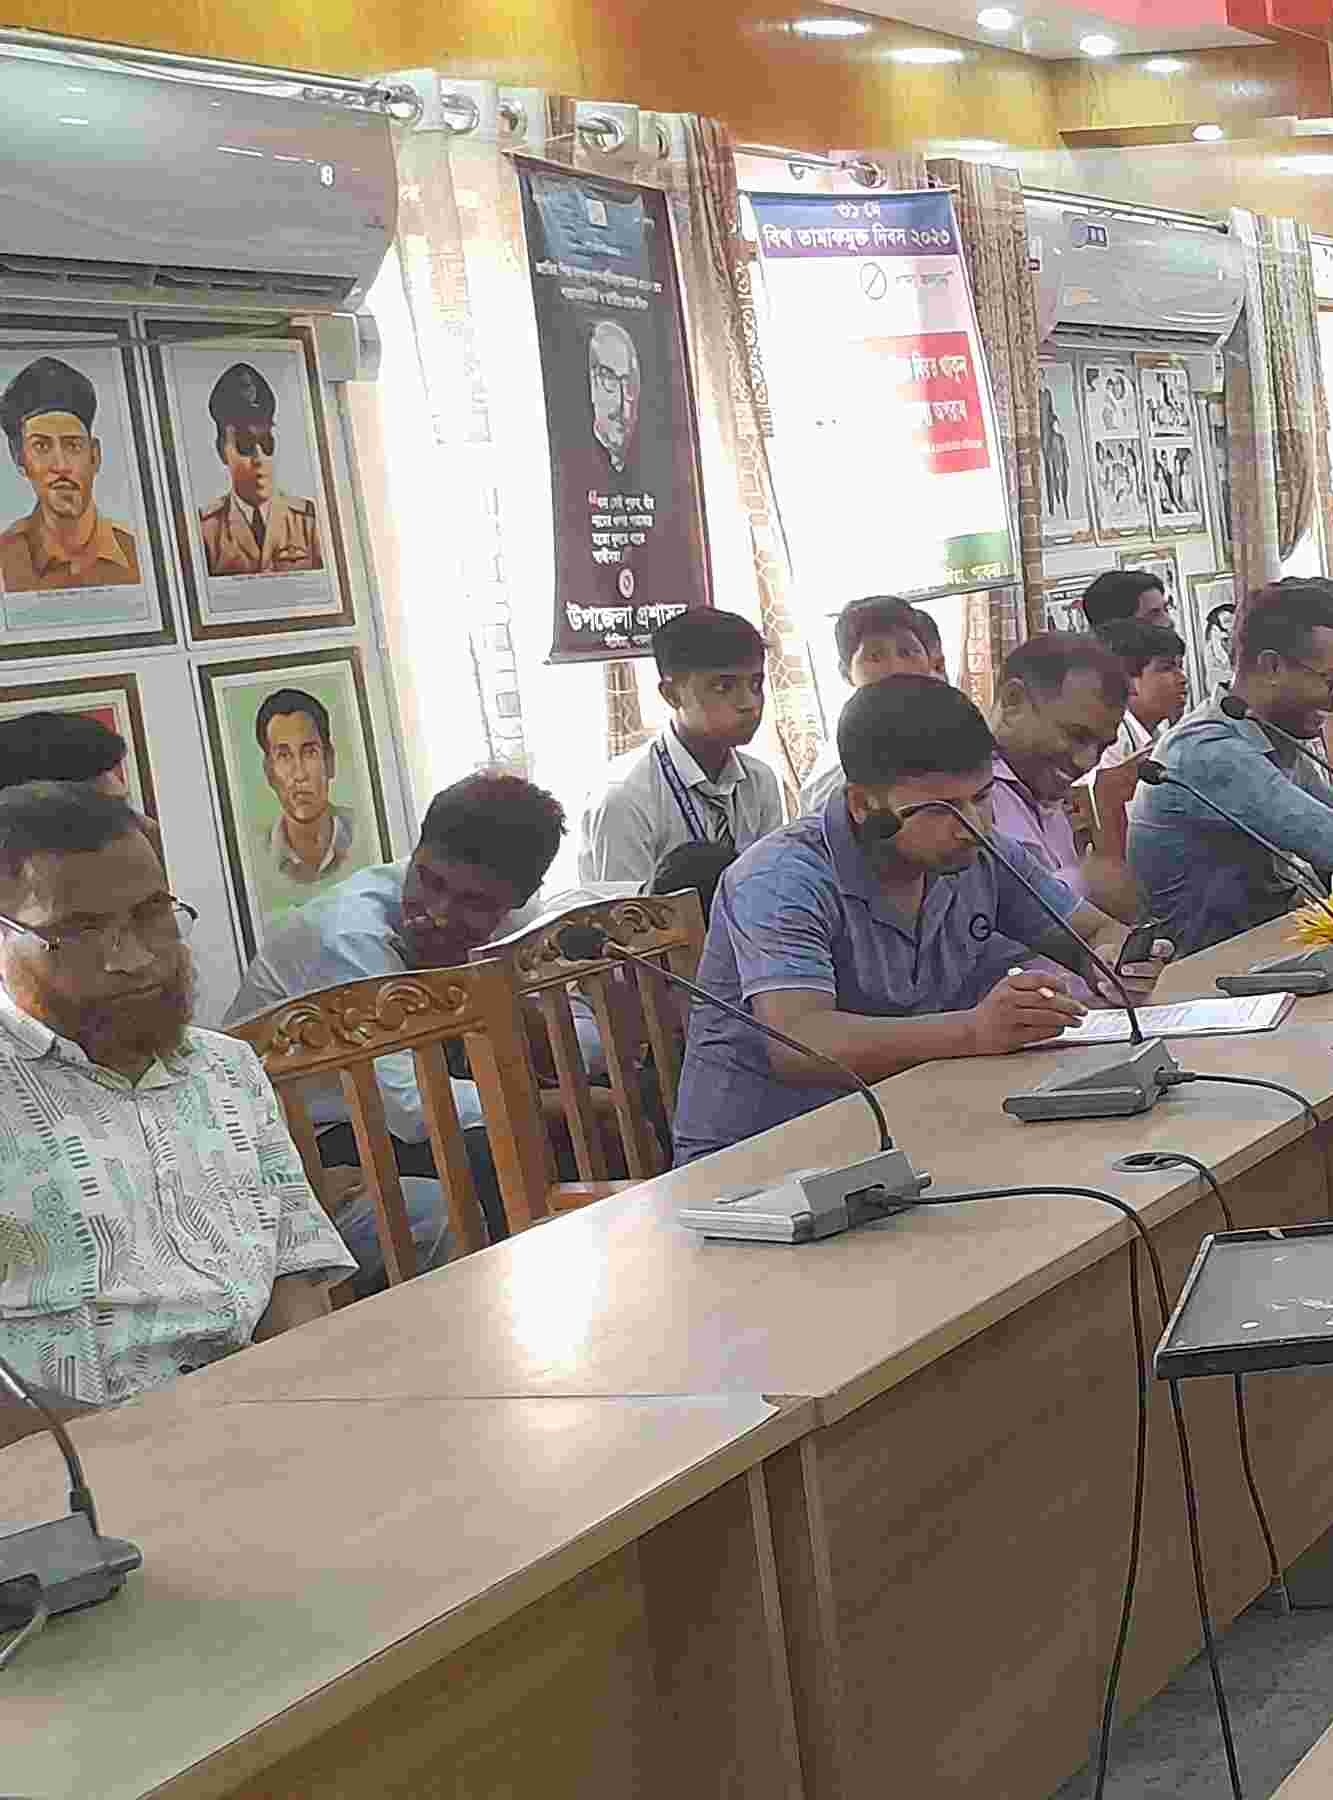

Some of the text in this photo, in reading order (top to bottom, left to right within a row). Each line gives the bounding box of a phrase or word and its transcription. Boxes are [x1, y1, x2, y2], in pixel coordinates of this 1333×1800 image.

[872, 223, 907, 247] দিবস
[911, 228, 950, 247] ২০২৩
[565, 600, 634, 632] উপজেলা
